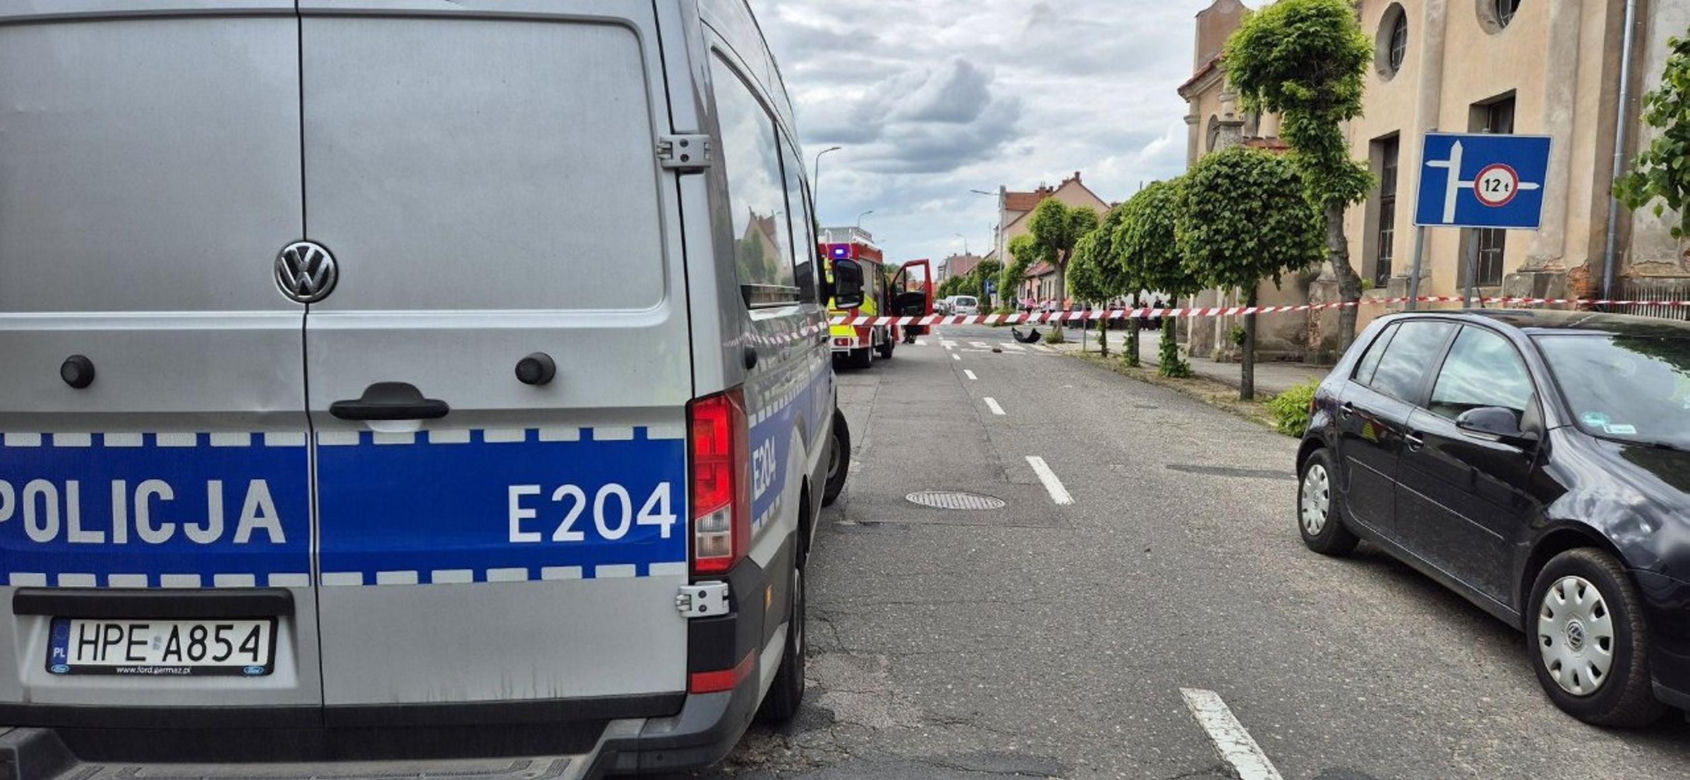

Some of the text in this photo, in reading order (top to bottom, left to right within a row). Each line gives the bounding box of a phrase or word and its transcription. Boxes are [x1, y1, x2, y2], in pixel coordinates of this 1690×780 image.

[1484, 178, 1509, 192] 12 t
[752, 435, 776, 500] E204
[508, 482, 677, 543] E204
[53, 647, 65, 657] PL
[77, 623, 260, 662] HPE A854
